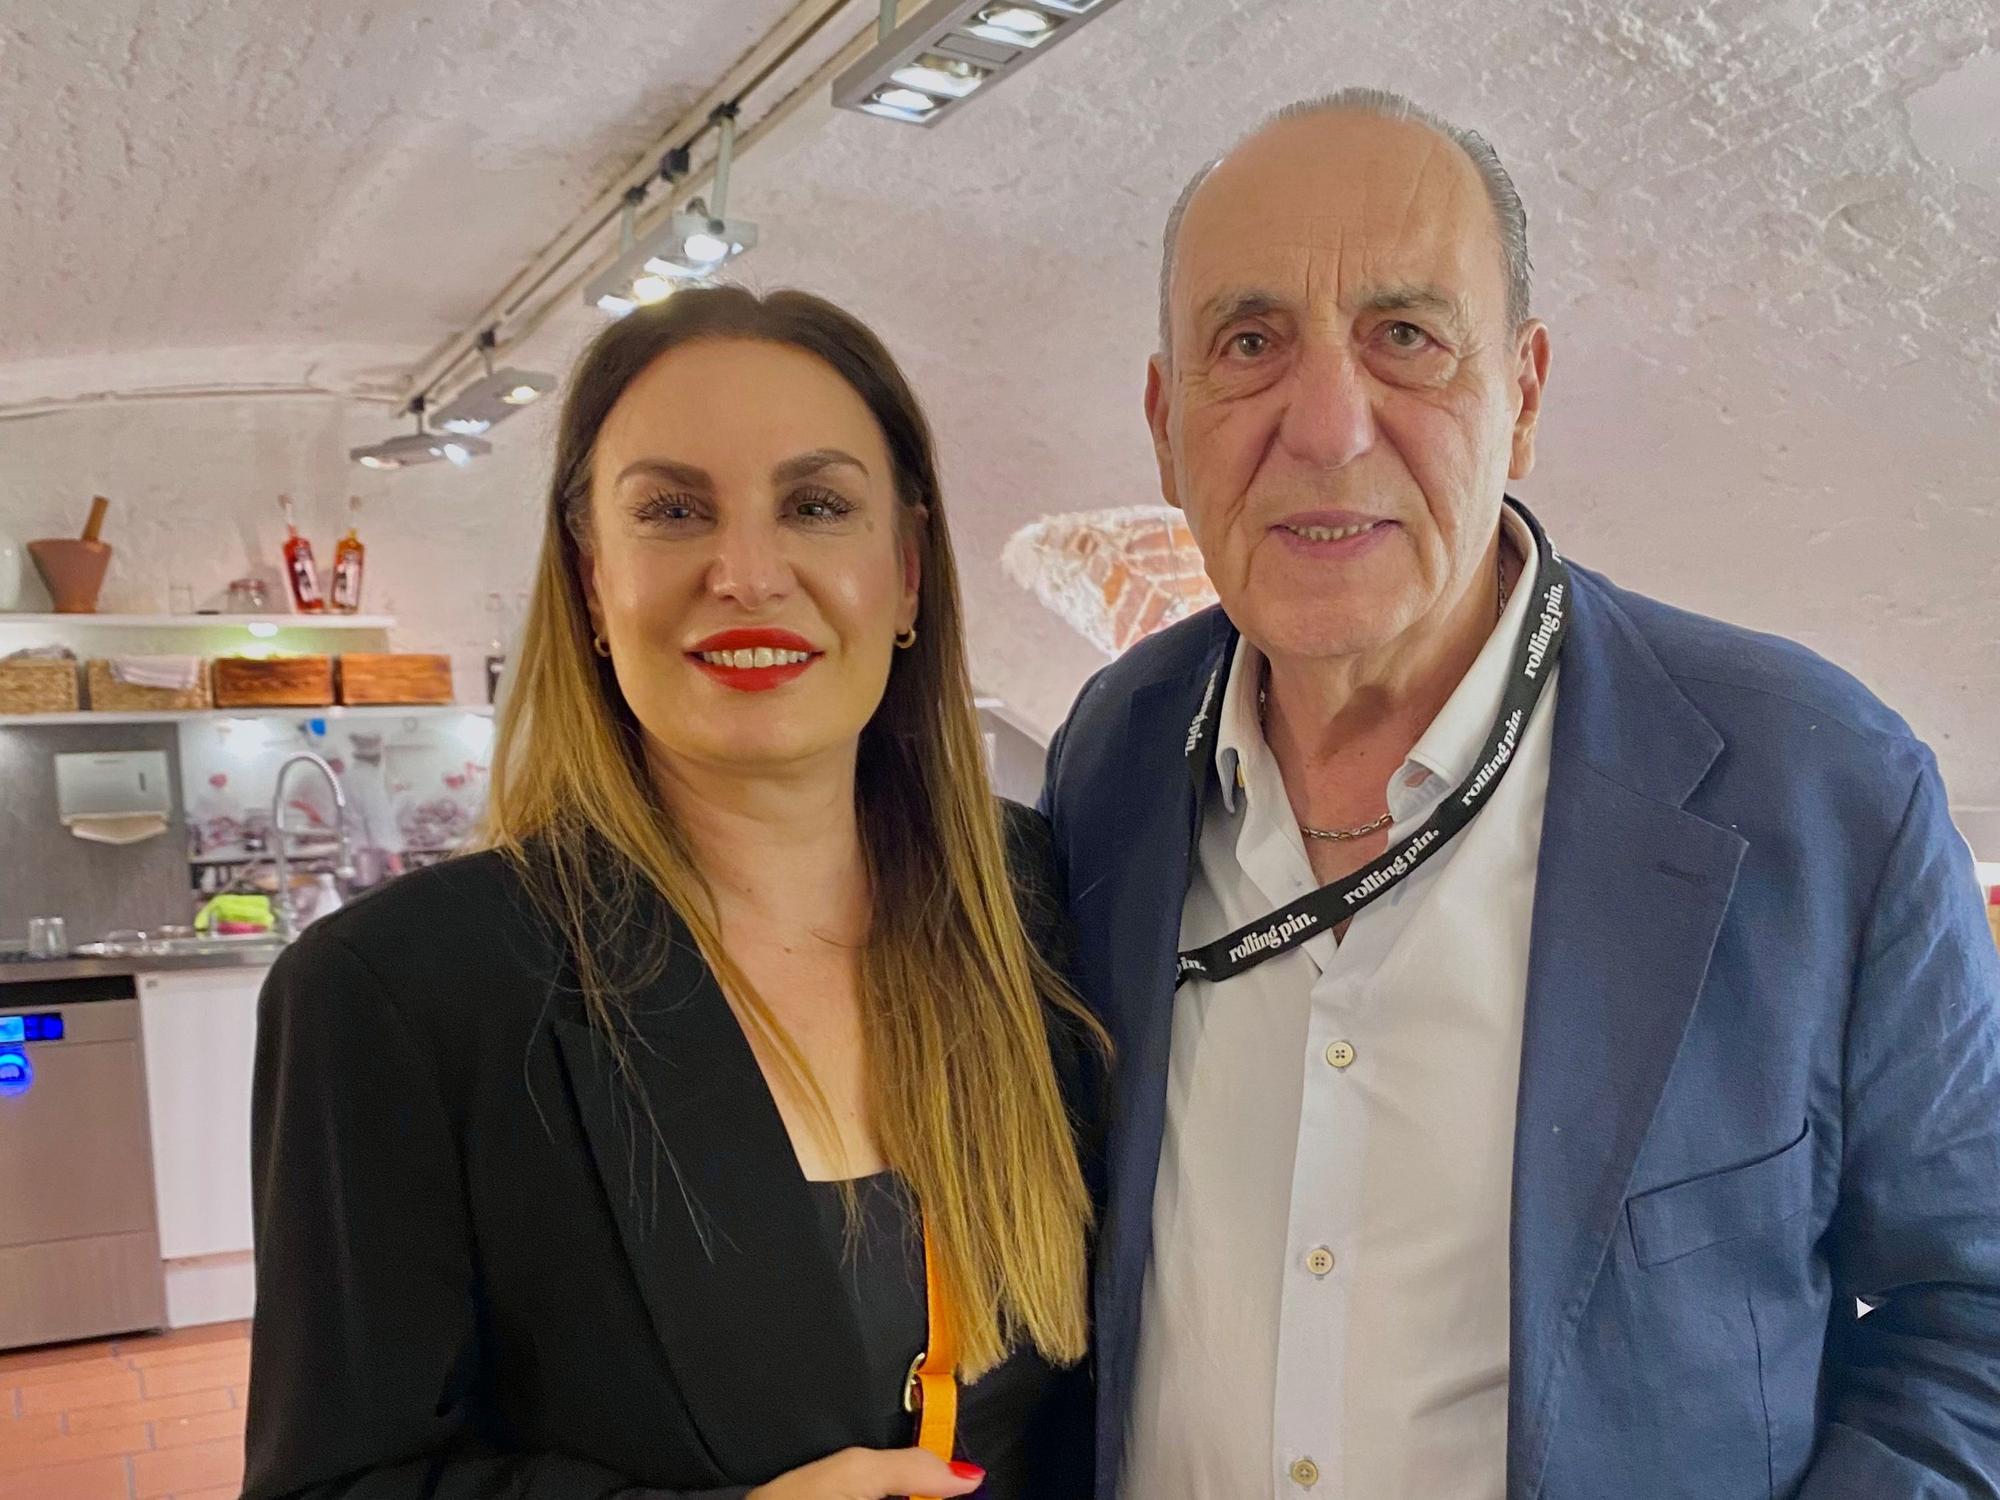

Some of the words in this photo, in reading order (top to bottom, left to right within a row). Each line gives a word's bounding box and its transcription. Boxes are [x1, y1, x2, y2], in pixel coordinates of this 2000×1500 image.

[1524, 612, 1560, 679] rolling
[1546, 583, 1564, 618] pin.
[1461, 741, 1511, 806] rolling
[1503, 709, 1522, 751] pin.
[1343, 855, 1408, 904] rolling
[1403, 829, 1439, 864] pin.
[1229, 924, 1282, 963] rolling
[1277, 913, 1318, 943] pin.
